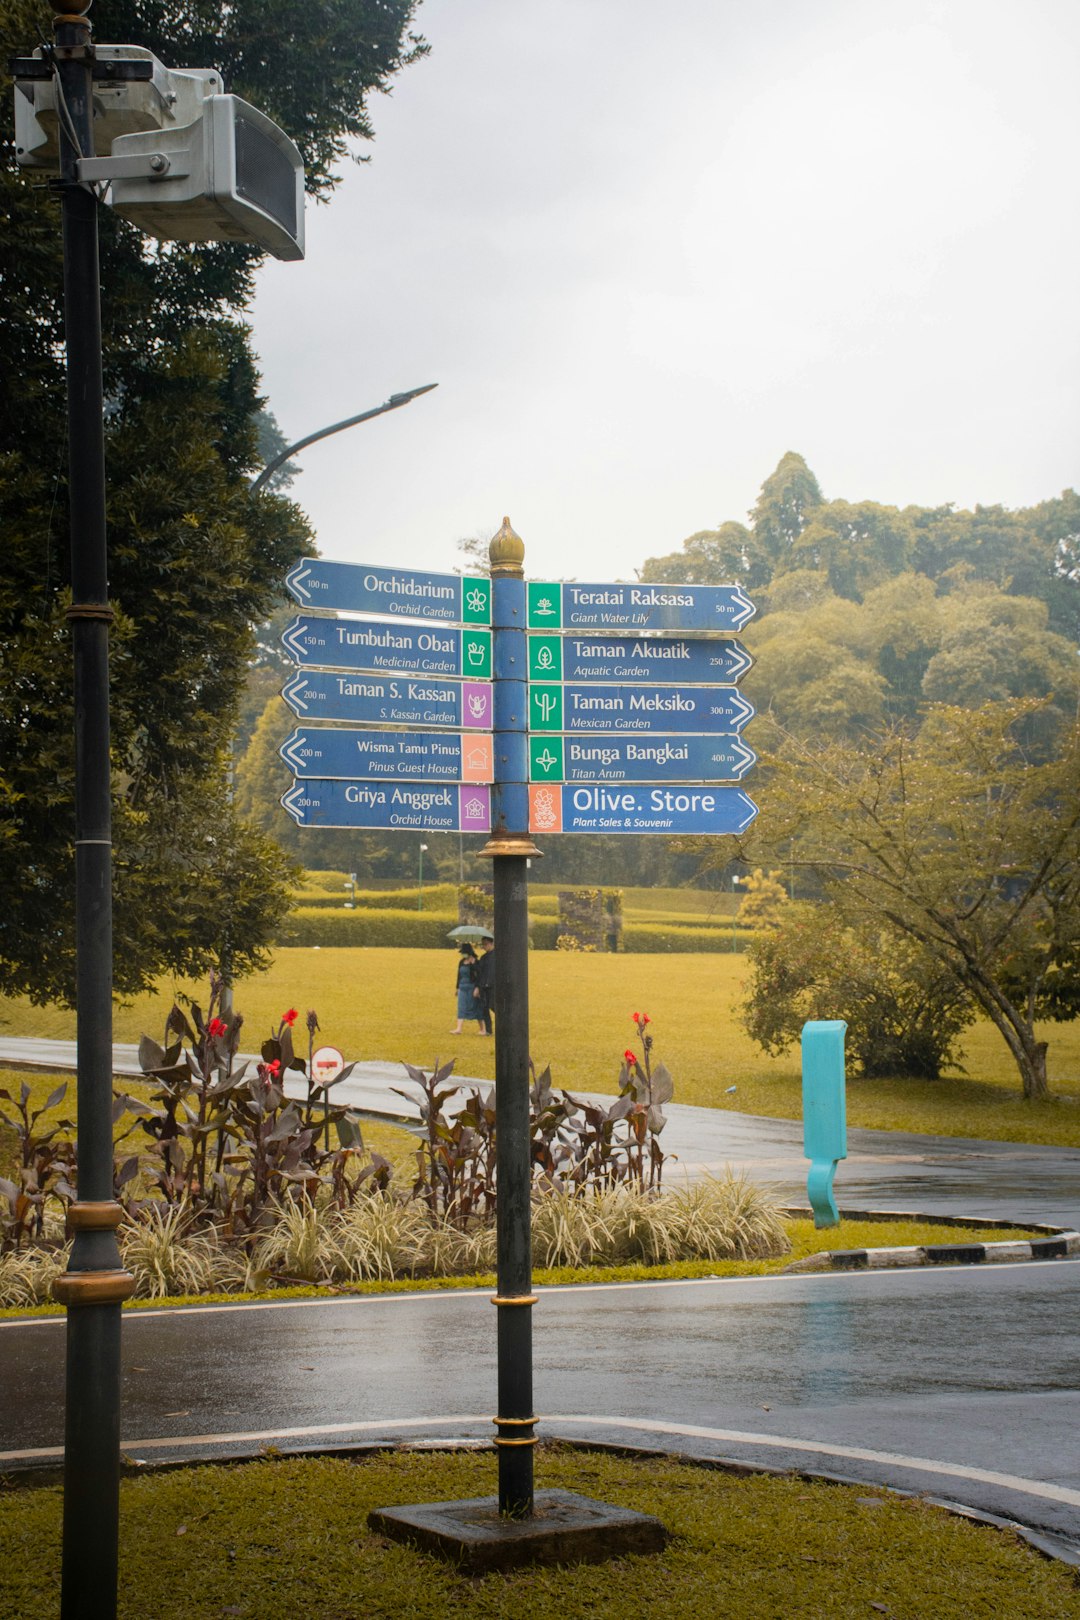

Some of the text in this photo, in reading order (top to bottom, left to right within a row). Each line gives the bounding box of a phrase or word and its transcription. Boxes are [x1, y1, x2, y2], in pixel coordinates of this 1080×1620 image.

[308, 580, 319, 588] 100
[364, 575, 454, 599] Orchidarium
[570, 589, 694, 606] Teratai Raksasa
[389, 603, 455, 618] Orchid Garden
[570, 613, 649, 626] Giant Water Lily
[336, 628, 455, 652] Tumbuhan Obat
[573, 642, 690, 659] Taman Akuatik
[373, 656, 456, 671] Medicinal Garden
[574, 666, 649, 677] Aquatic Garden
[304, 690, 316, 699] 200
[337, 679, 456, 702] Taman S. Kassan
[571, 694, 695, 711] Taman Meksiko
[380, 709, 456, 722] S. Kassan Garden
[571, 718, 650, 728] Mexican Garden
[300, 748, 313, 757] 200
[358, 742, 460, 755] Wisma Tamu Pinus
[570, 744, 688, 764] Bunga Bangkai
[369, 762, 458, 774] Pinus Guest House
[571, 769, 625, 778] Titan Arum
[297, 798, 310, 806] 200
[346, 787, 452, 809] Griya Anggrek
[573, 788, 715, 812] Olive. Store
[390, 814, 452, 825] Orchid House
[573, 818, 672, 827] Plant Sales & Souvenir
